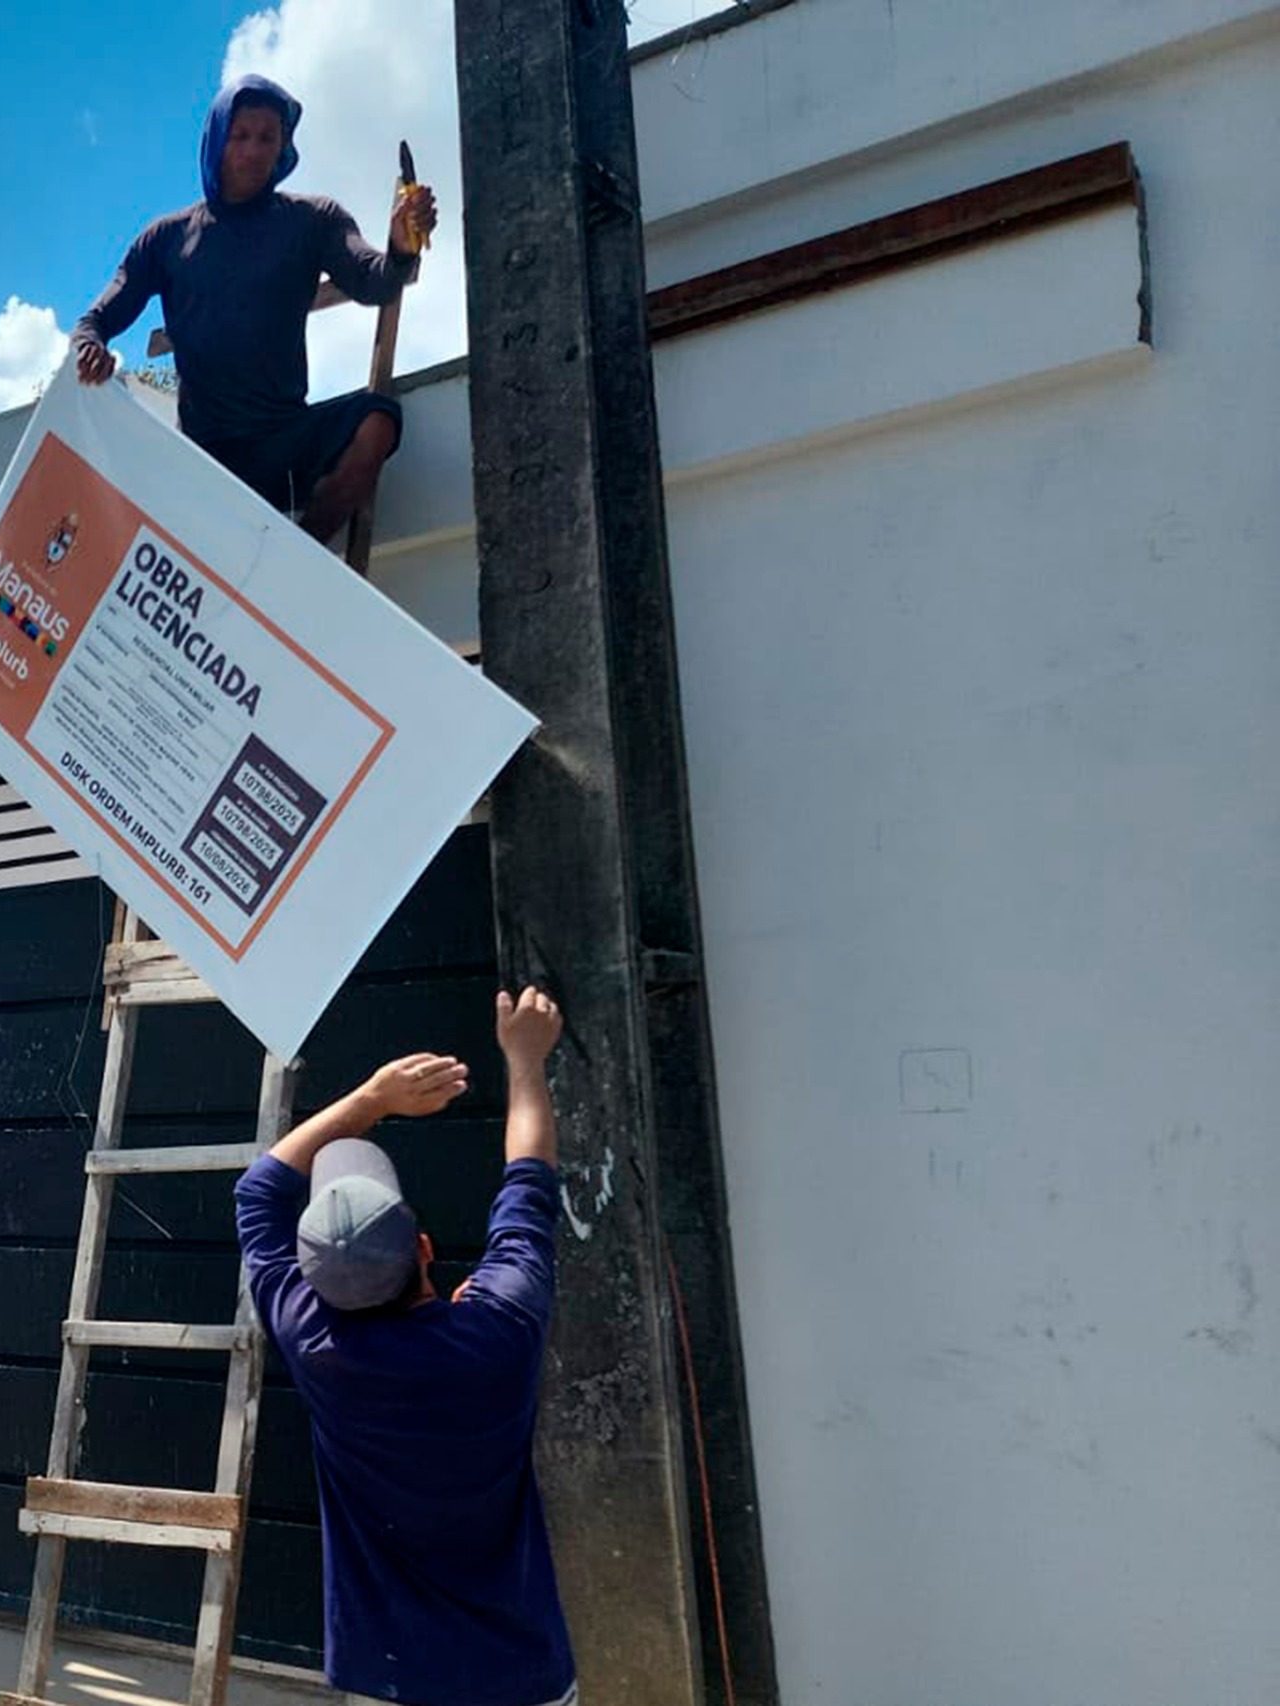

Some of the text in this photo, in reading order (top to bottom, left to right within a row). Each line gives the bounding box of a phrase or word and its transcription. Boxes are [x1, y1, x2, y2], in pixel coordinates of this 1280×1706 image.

[115, 569, 262, 717] LICENCIADA
[134, 542, 204, 619] OBRA
[60, 751, 91, 786] DISK
[88, 780, 133, 828] ORDEM
[130, 821, 189, 884] IMPLURB:
[188, 877, 212, 905] 161
